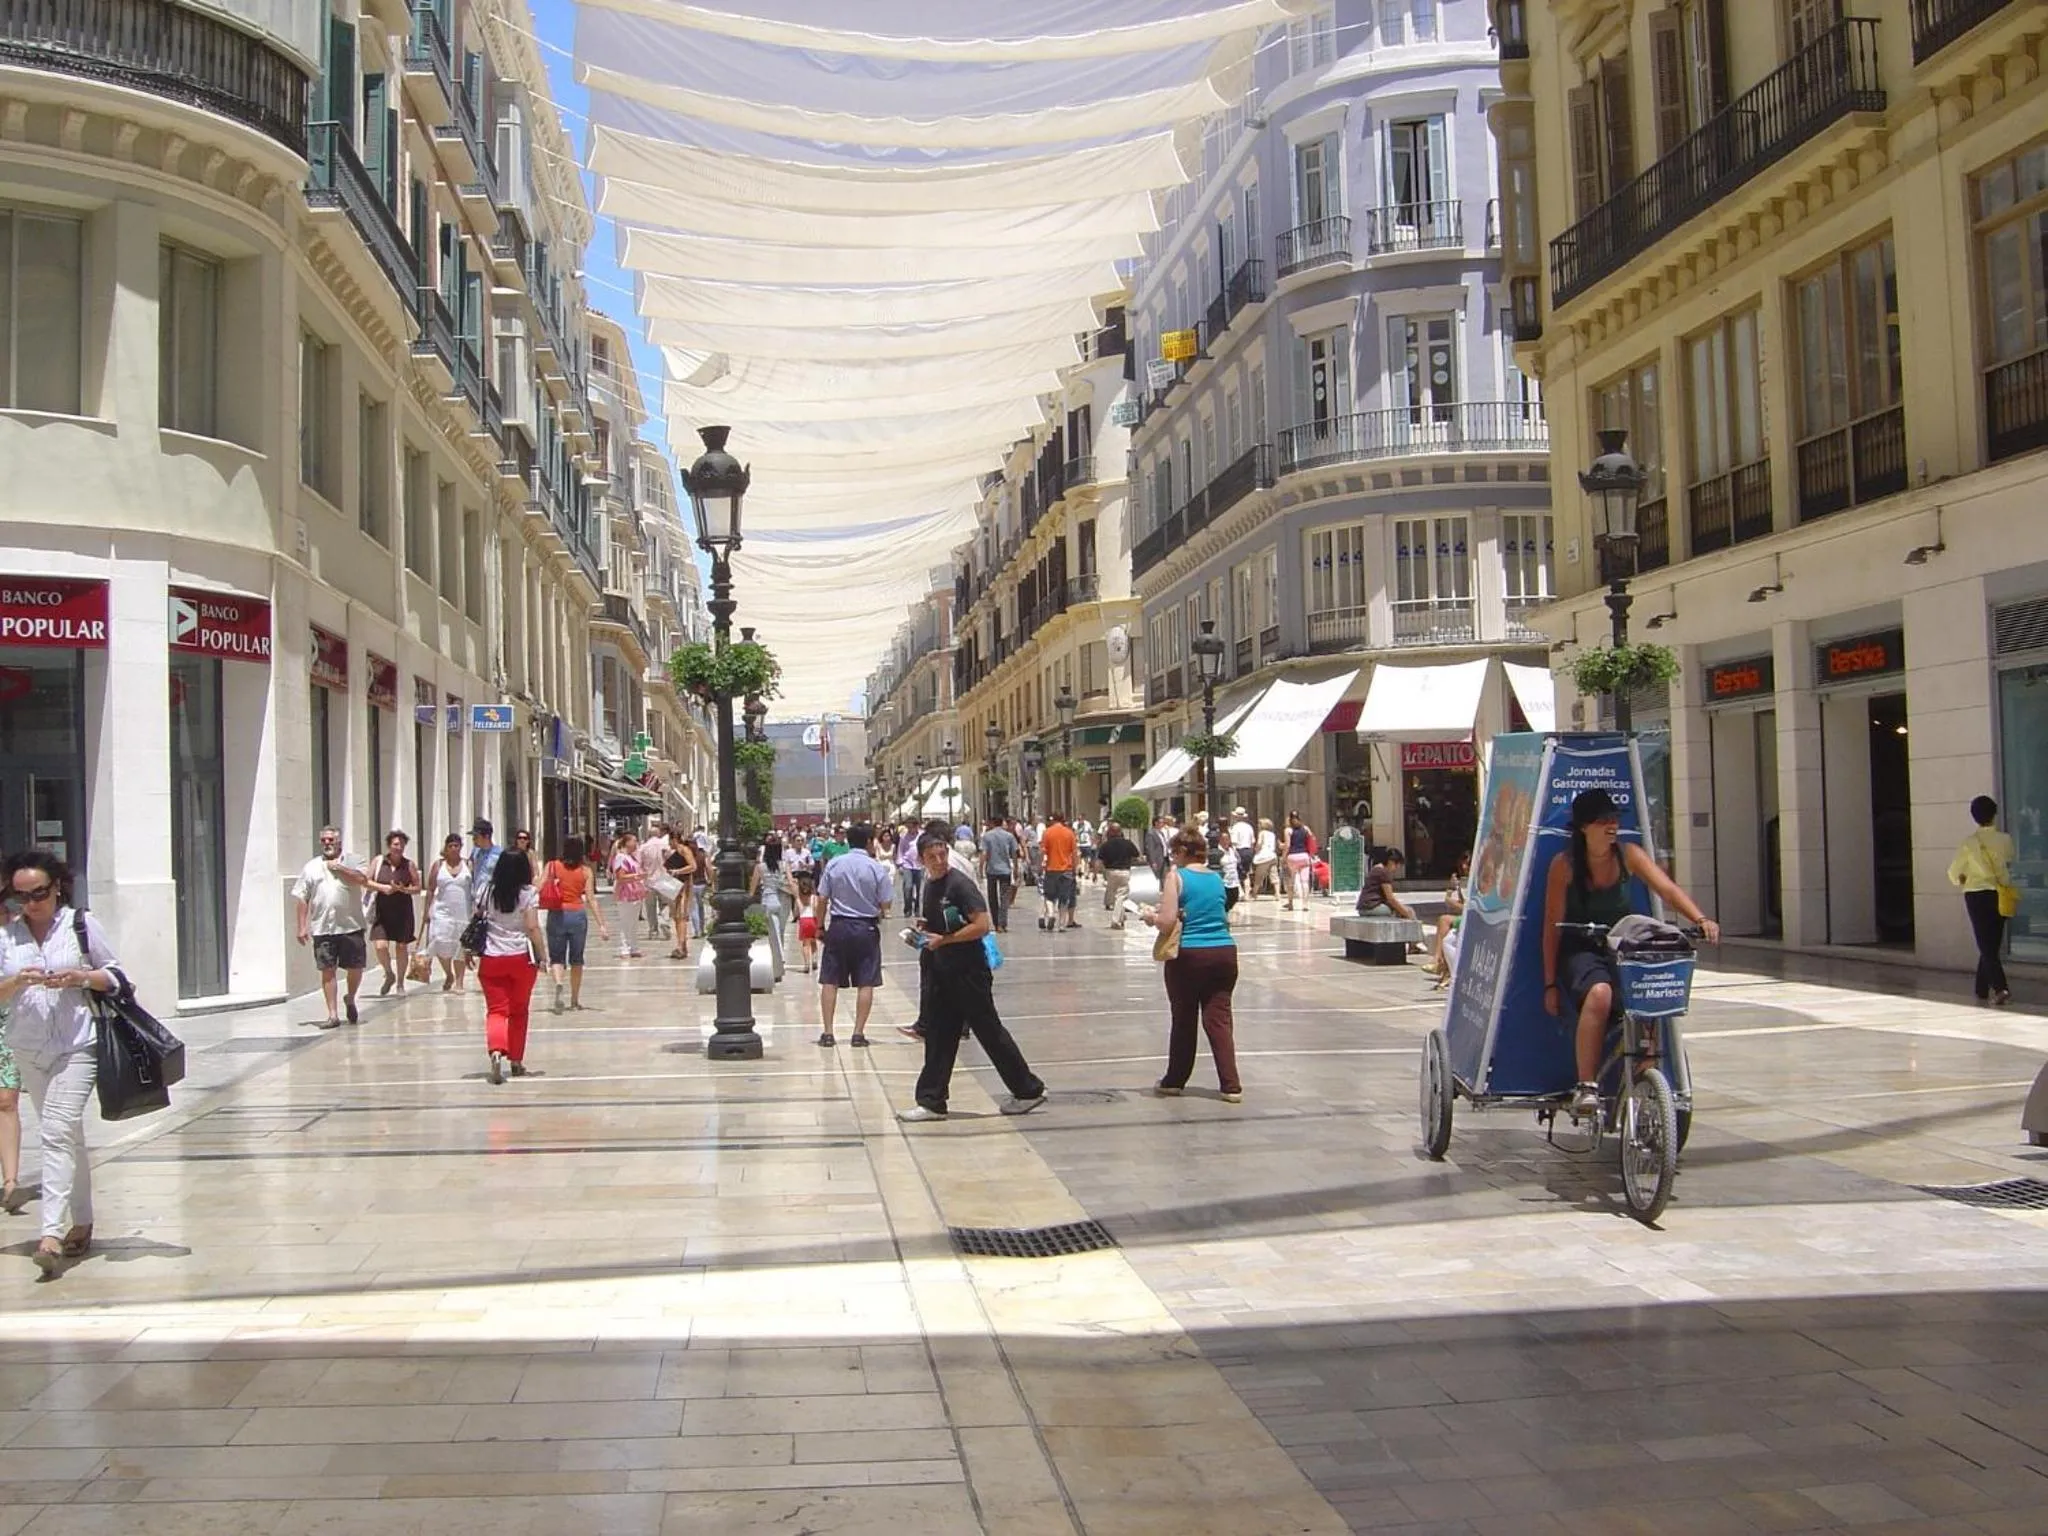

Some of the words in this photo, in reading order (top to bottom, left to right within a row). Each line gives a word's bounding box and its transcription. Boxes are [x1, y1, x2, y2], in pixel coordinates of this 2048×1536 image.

[1, 590, 63, 606] BANCO
[201, 603, 239, 622] BANCO
[1, 617, 106, 640] POPULAR
[201, 629, 271, 655] POPULAR
[1567, 766, 1616, 777] Jornadas
[1552, 778, 1631, 789] Gastronómicas
[1552, 795, 1567, 804] del
[1646, 988, 1685, 999] Marisco
